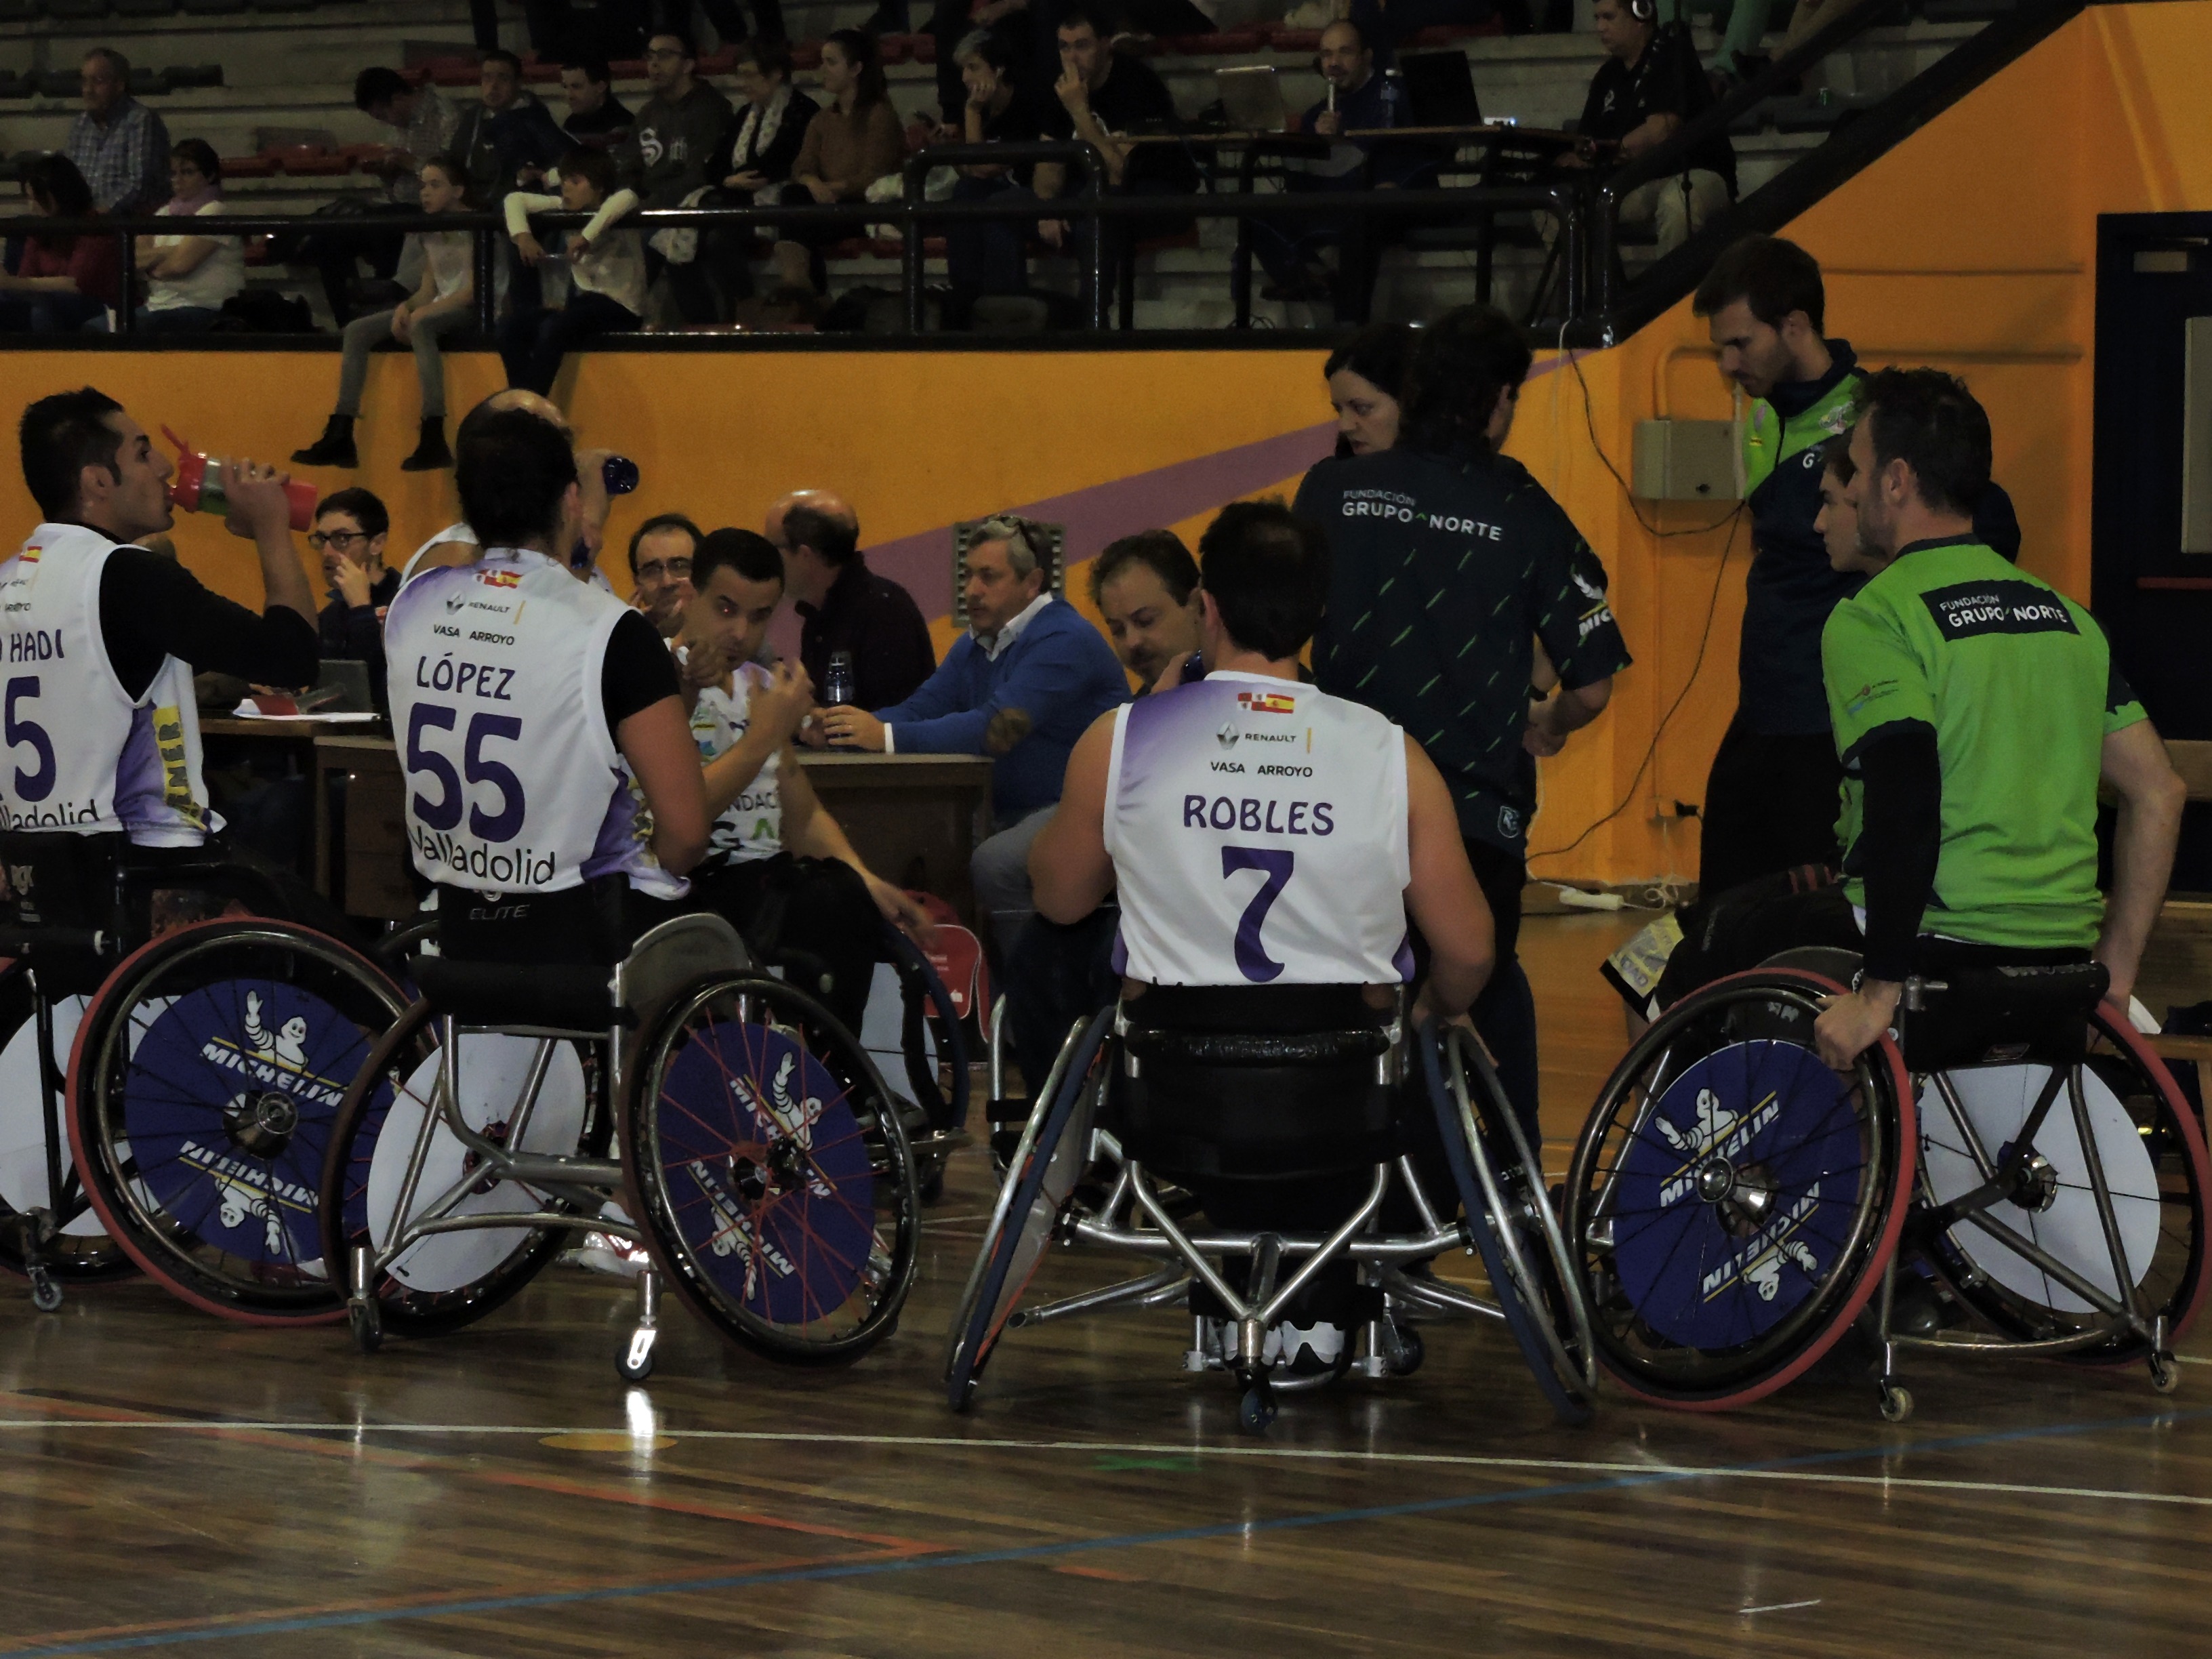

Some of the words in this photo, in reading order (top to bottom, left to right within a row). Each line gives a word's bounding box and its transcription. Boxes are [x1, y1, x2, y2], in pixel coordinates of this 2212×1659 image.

[1342, 501, 1414, 523] GRUPO
[1429, 514, 1503, 541] NORTE
[468, 602, 510, 613] RENAULT
[1578, 608, 1612, 636] MIC
[1948, 606, 2006, 628] GRUPO
[2013, 604, 2068, 623] NORTE
[10, 629, 64, 663] HADI
[433, 623, 460, 638] VASA
[469, 630, 515, 646] ARROYO
[417, 652, 516, 701] LÓPEZ
[0, 676, 56, 802] 5
[1244, 733, 1296, 743] RENAULT
[407, 702, 526, 843] 55
[1210, 760, 1245, 774] VASA
[1257, 764, 1313, 777] ARROYO
[0, 798, 100, 831] lladolid
[1183, 794, 1334, 836] ROBLES
[407, 825, 555, 885] Valladolid
[1221, 846, 1294, 983] 7
[201, 1043, 344, 1107] MICHELIN
[180, 1141, 319, 1208] MICHELIN
[1702, 1181, 1820, 1294] MICHELIN
